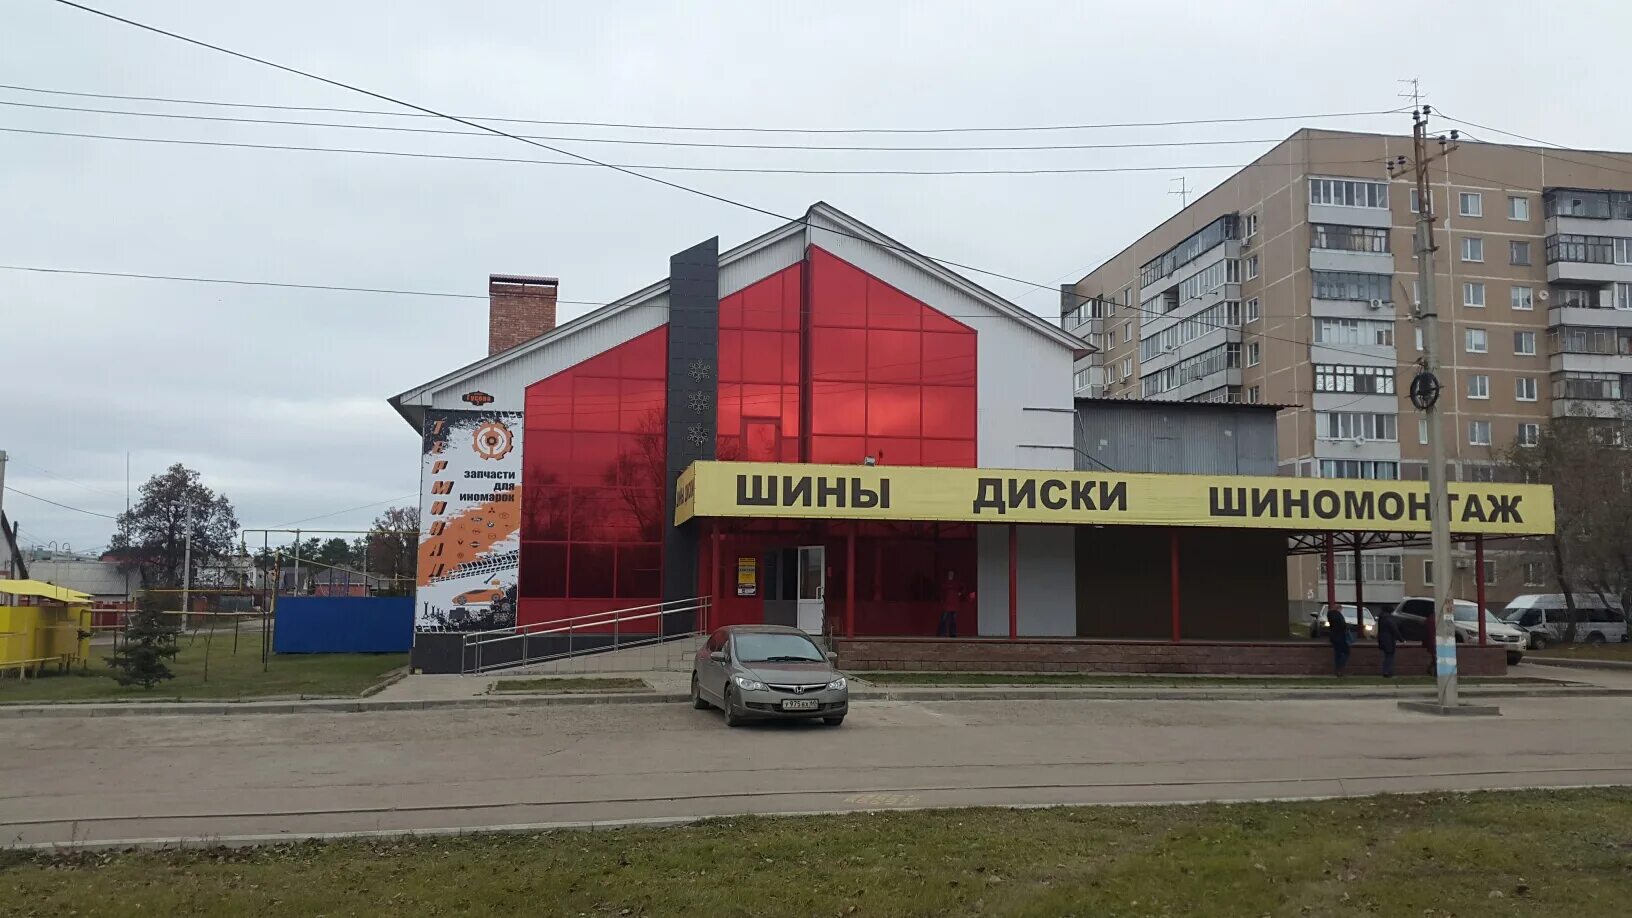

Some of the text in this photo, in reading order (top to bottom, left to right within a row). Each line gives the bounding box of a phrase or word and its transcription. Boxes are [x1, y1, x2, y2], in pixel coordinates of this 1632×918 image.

[464, 470, 516, 479] запчасти
[493, 482, 515, 491] для
[429, 420, 454, 577] ТЕРМИНАЛ
[459, 493, 515, 503] иномарок
[737, 475, 890, 508] ШИНЫ
[973, 478, 1127, 514] ДИСКИ
[1209, 486, 1524, 523] ШИНОМОНТАЖ
